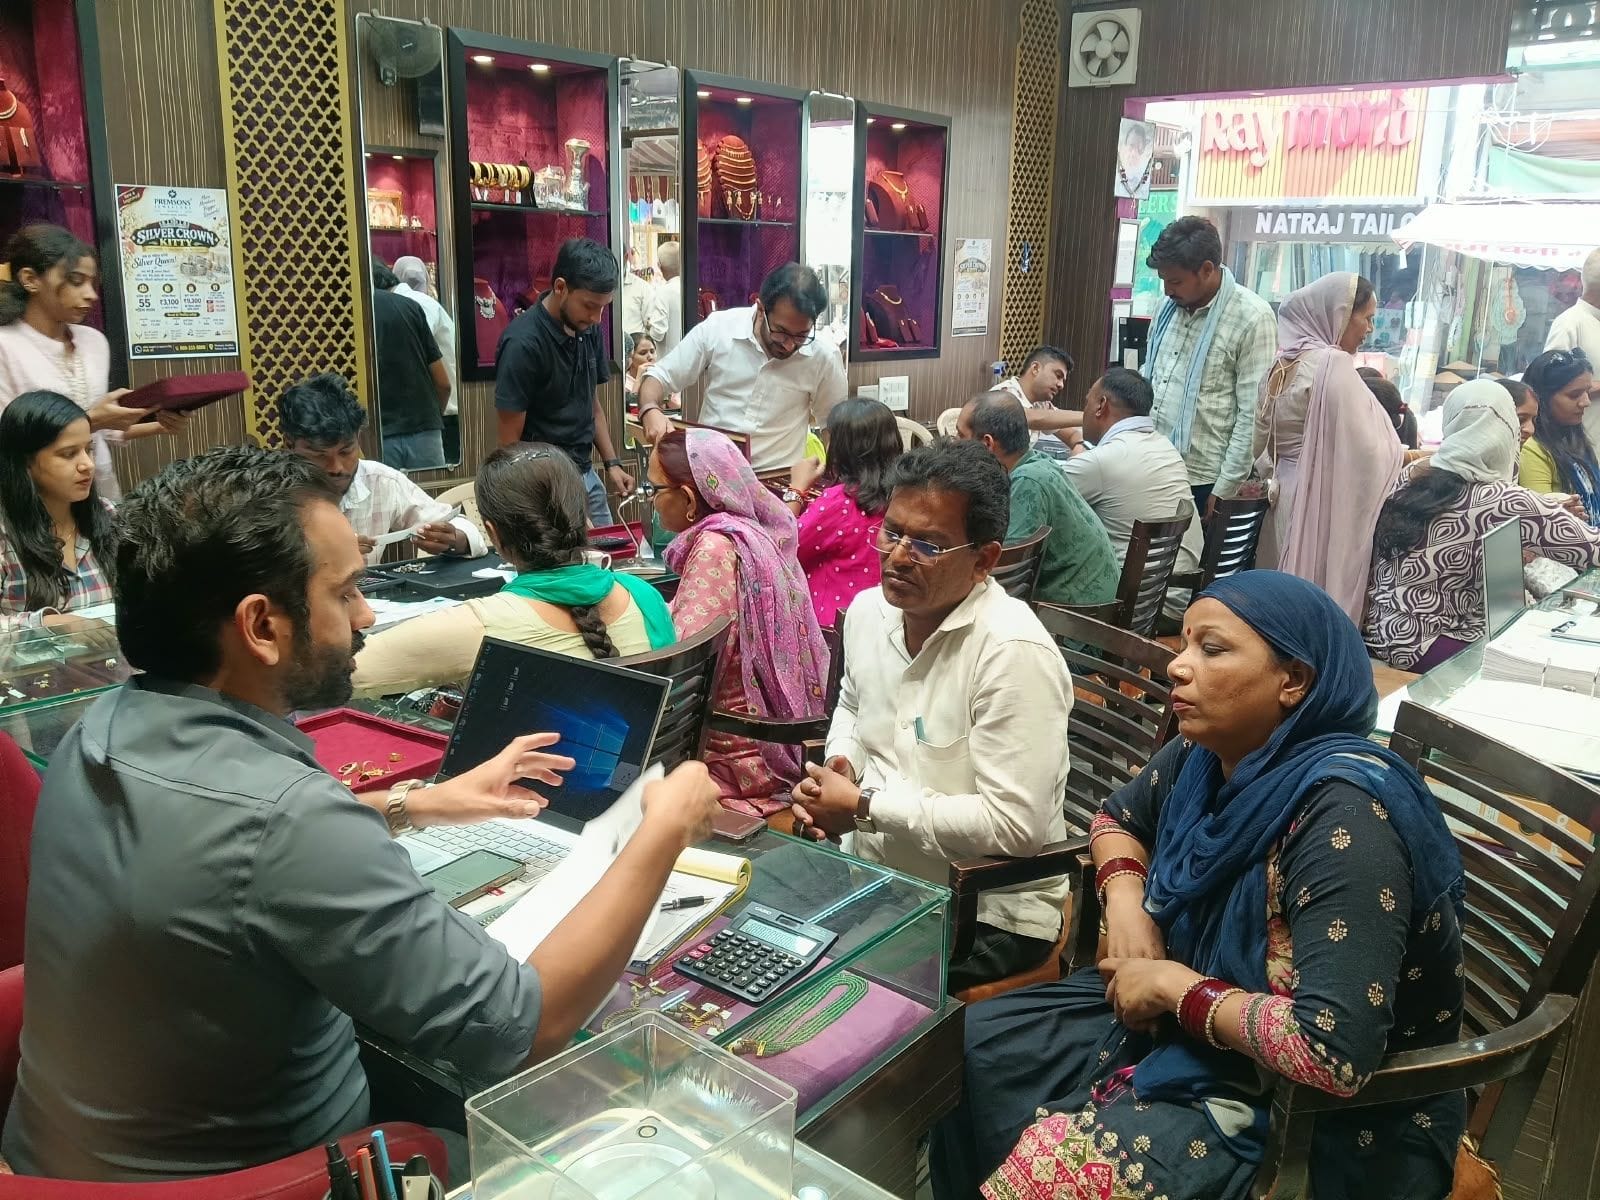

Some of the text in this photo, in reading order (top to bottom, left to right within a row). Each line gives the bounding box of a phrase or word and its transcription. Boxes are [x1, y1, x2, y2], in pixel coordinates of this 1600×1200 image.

[1255, 212, 1345, 235] NATRAJ
[136, 227, 215, 246] SILVER CROWN
[160, 238, 193, 247] KITTY
[131, 257, 153, 269] Silver
[138, 298, 151, 308] 55
